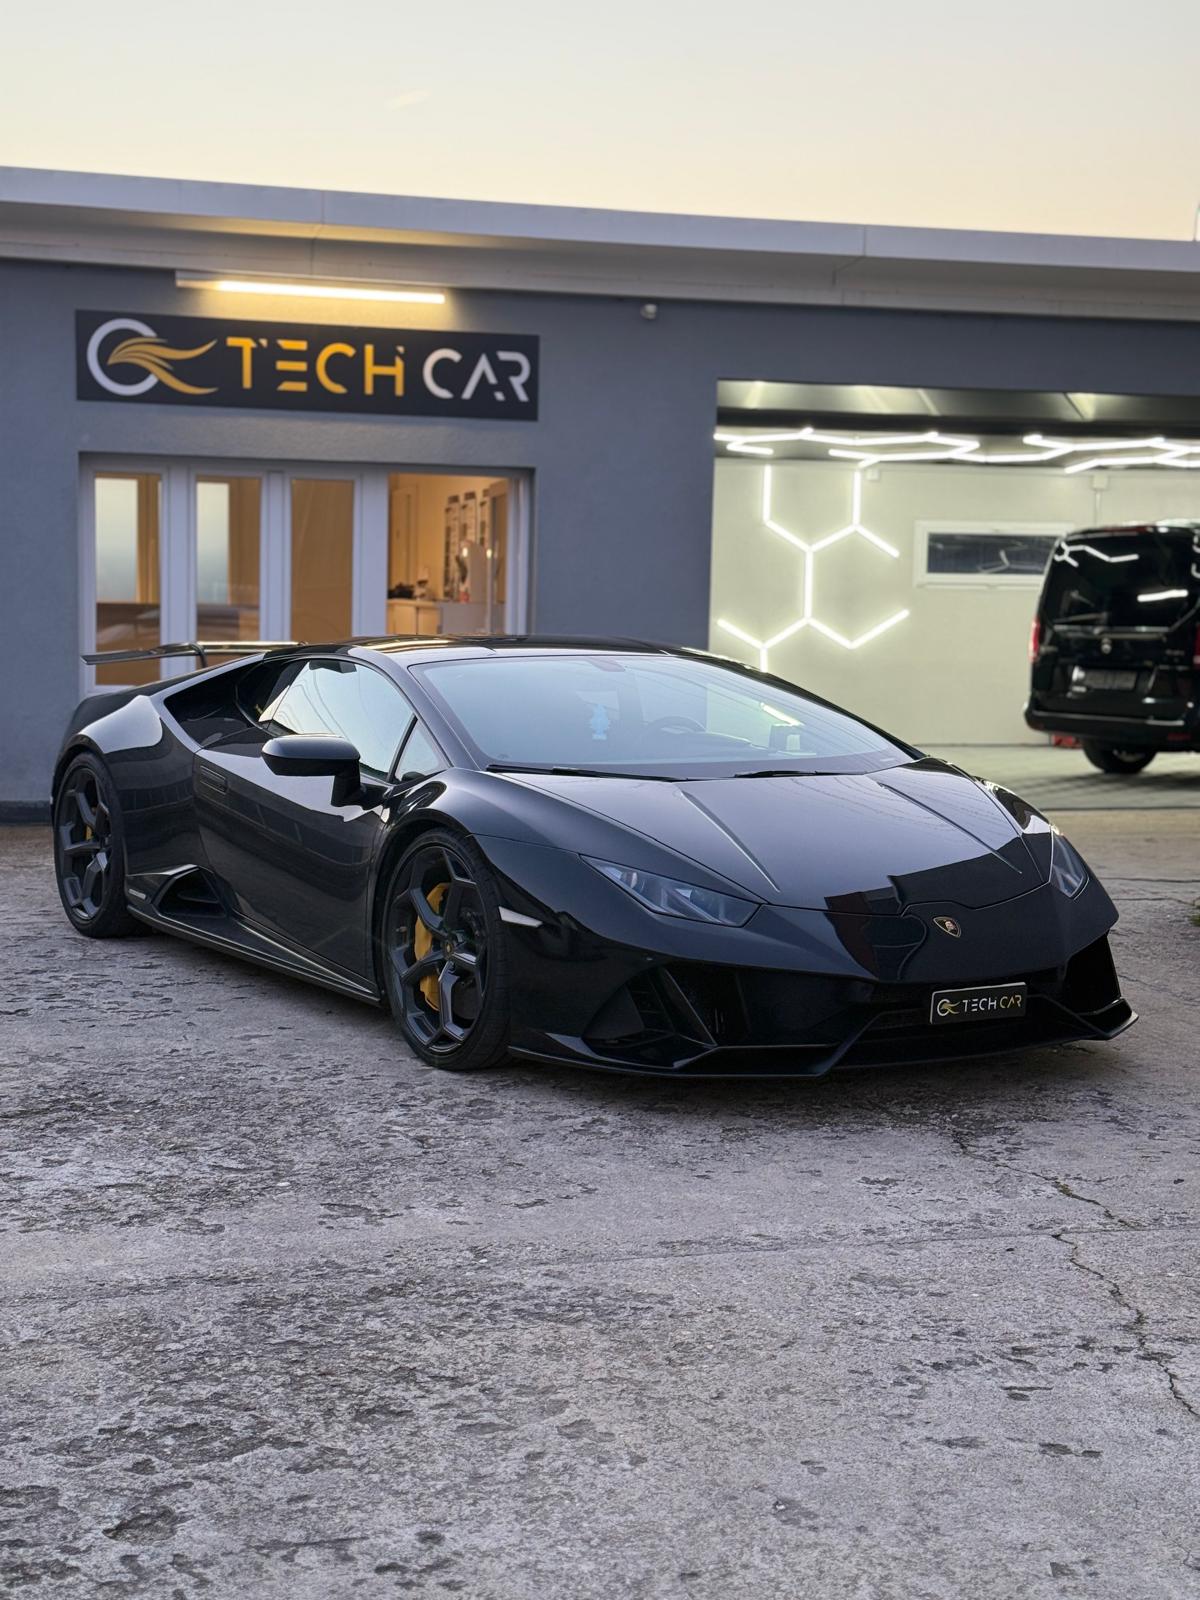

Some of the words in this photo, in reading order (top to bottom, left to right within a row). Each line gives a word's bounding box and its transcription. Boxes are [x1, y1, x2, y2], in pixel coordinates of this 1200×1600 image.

[226, 336, 405, 397] TECH
[422, 347, 531, 402] CAR
[962, 997, 997, 1012] TECH
[999, 994, 1022, 1009] CAR
